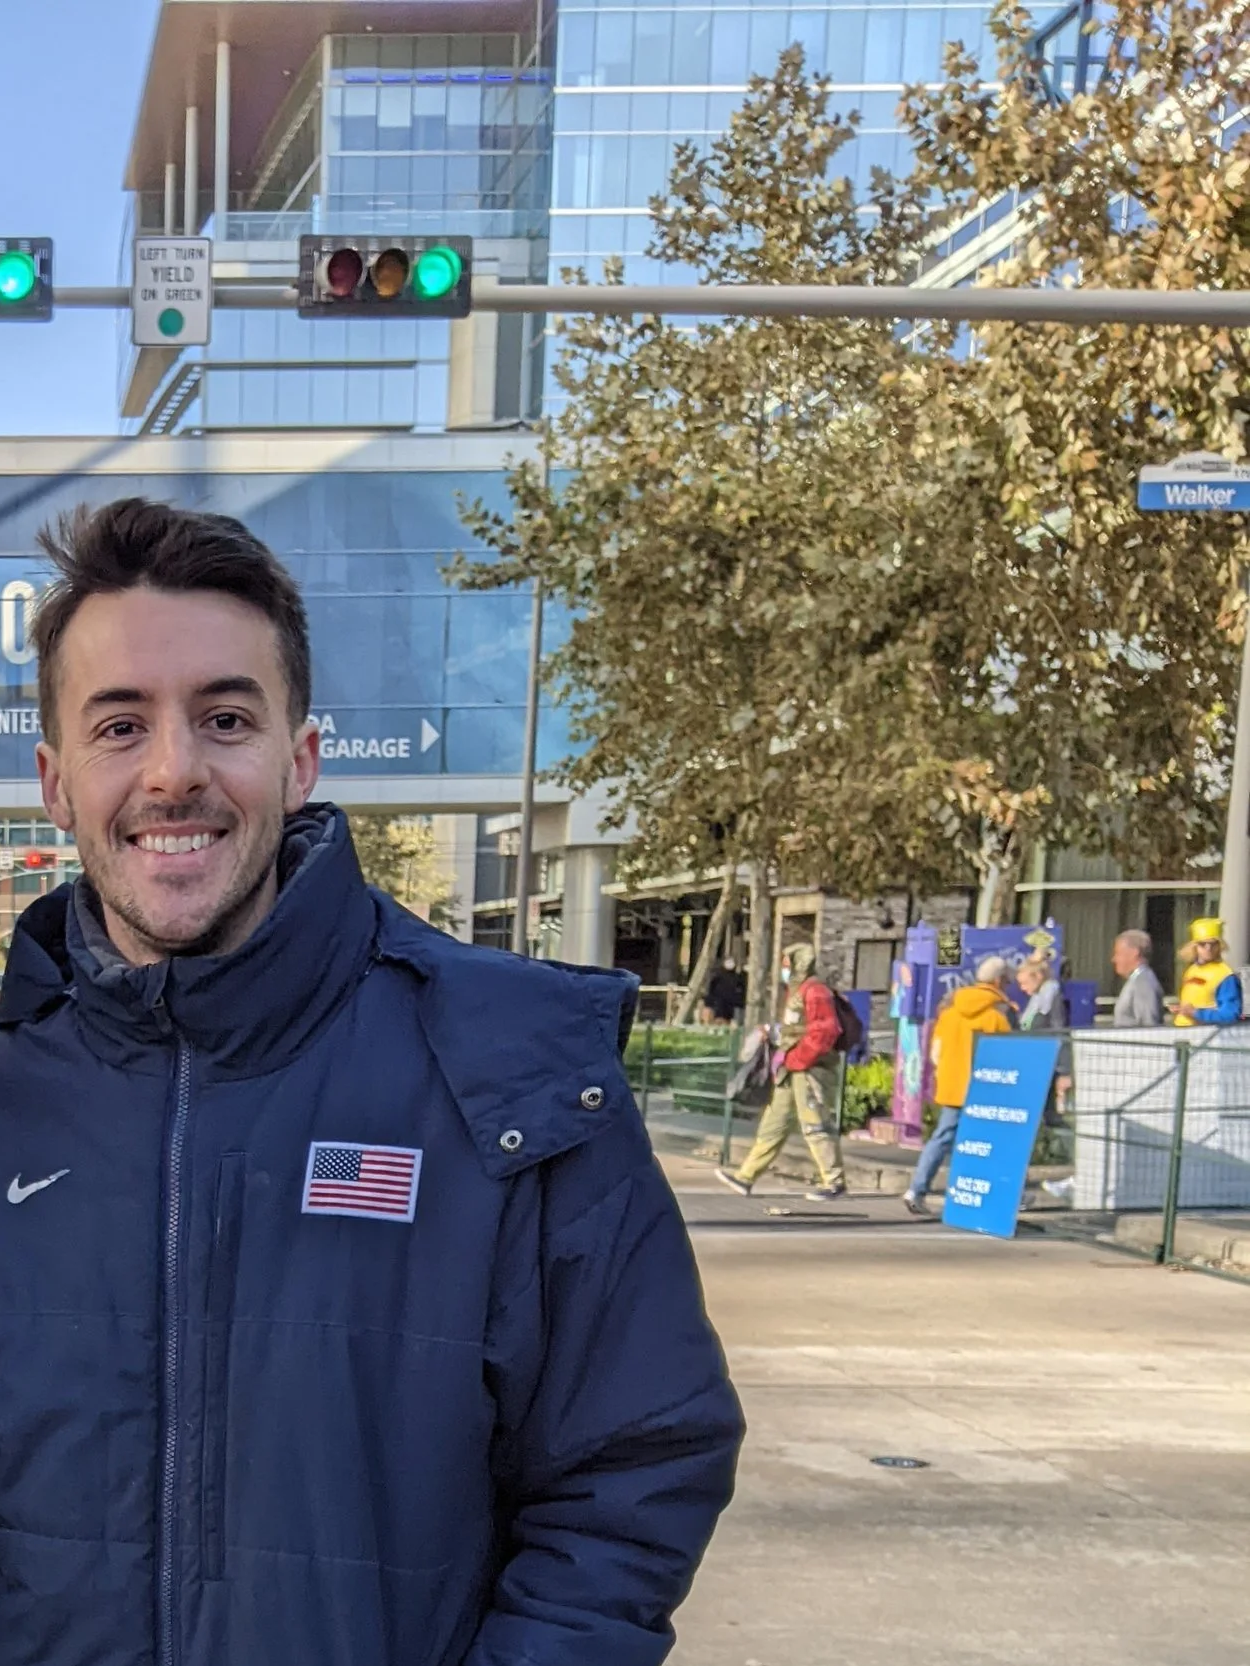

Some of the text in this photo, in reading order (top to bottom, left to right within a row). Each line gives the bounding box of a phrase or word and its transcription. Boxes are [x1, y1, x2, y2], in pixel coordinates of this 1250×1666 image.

[139, 247, 206, 260] LEFT TURN
[151, 266, 194, 282] YIELD
[140, 288, 202, 301] ON GREEN
[1164, 484, 1236, 505] Walker
[319, 737, 411, 758] GARAGE
